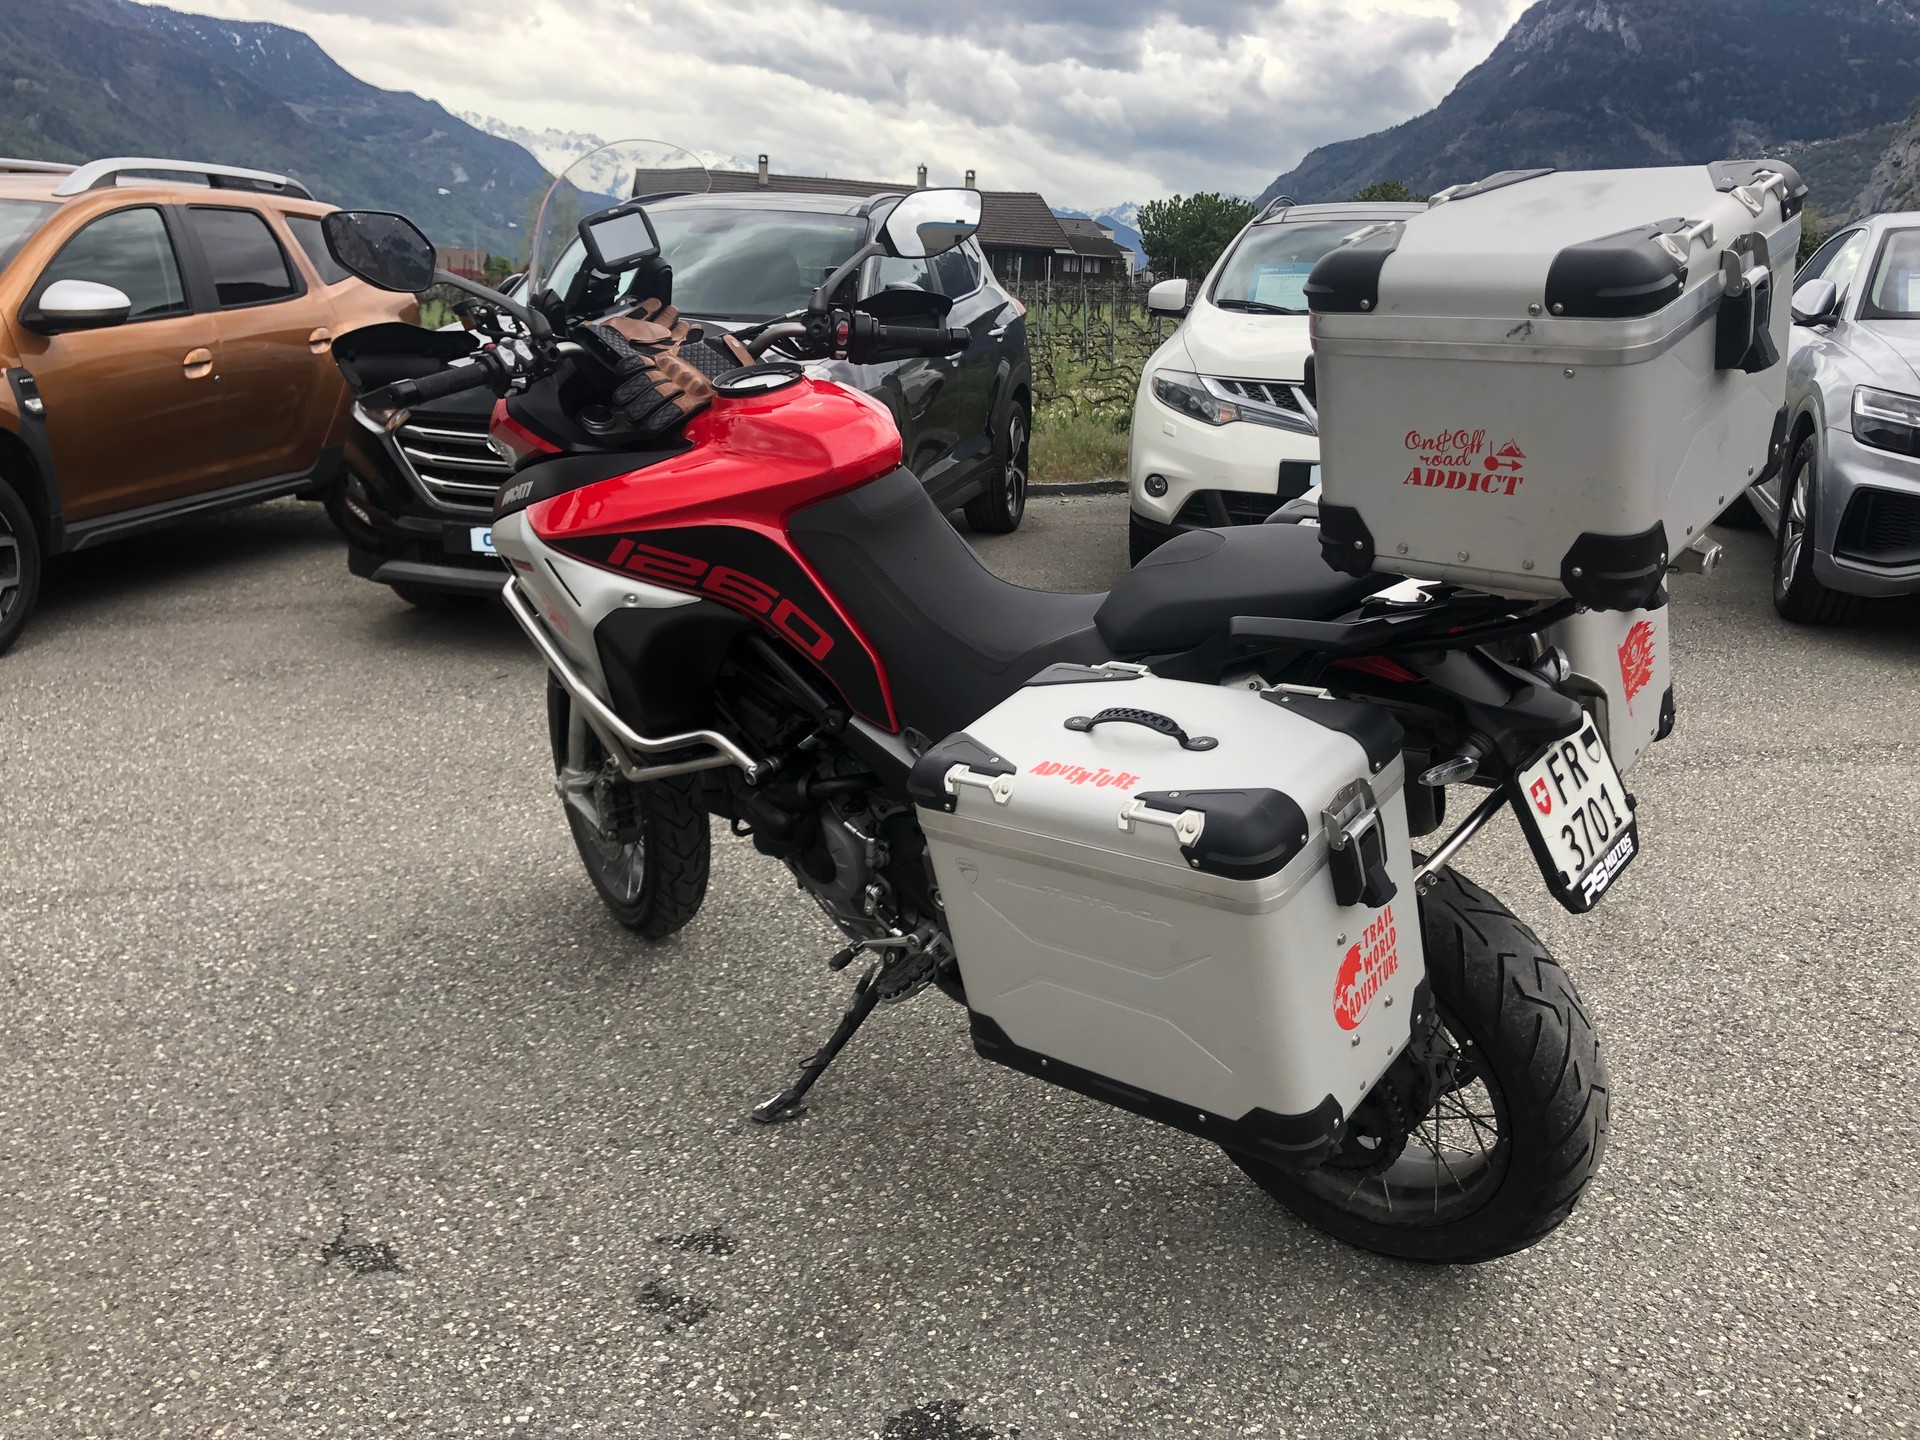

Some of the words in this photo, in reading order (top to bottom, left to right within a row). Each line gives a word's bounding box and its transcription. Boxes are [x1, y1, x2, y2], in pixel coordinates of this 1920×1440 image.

[1419, 446, 1472, 467] road
[1402, 467, 1524, 495] ADDICT
[607, 537, 835, 661] 1260
[1028, 760, 1141, 791] ADVENTURE
[1545, 741, 1589, 806] FR
[1561, 783, 1623, 872] 3701
[1581, 861, 1610, 907] PS
[1362, 904, 1394, 949] TRAIL
[1363, 926, 1397, 976] WORLD
[1348, 948, 1399, 1021] ADVENTURE
